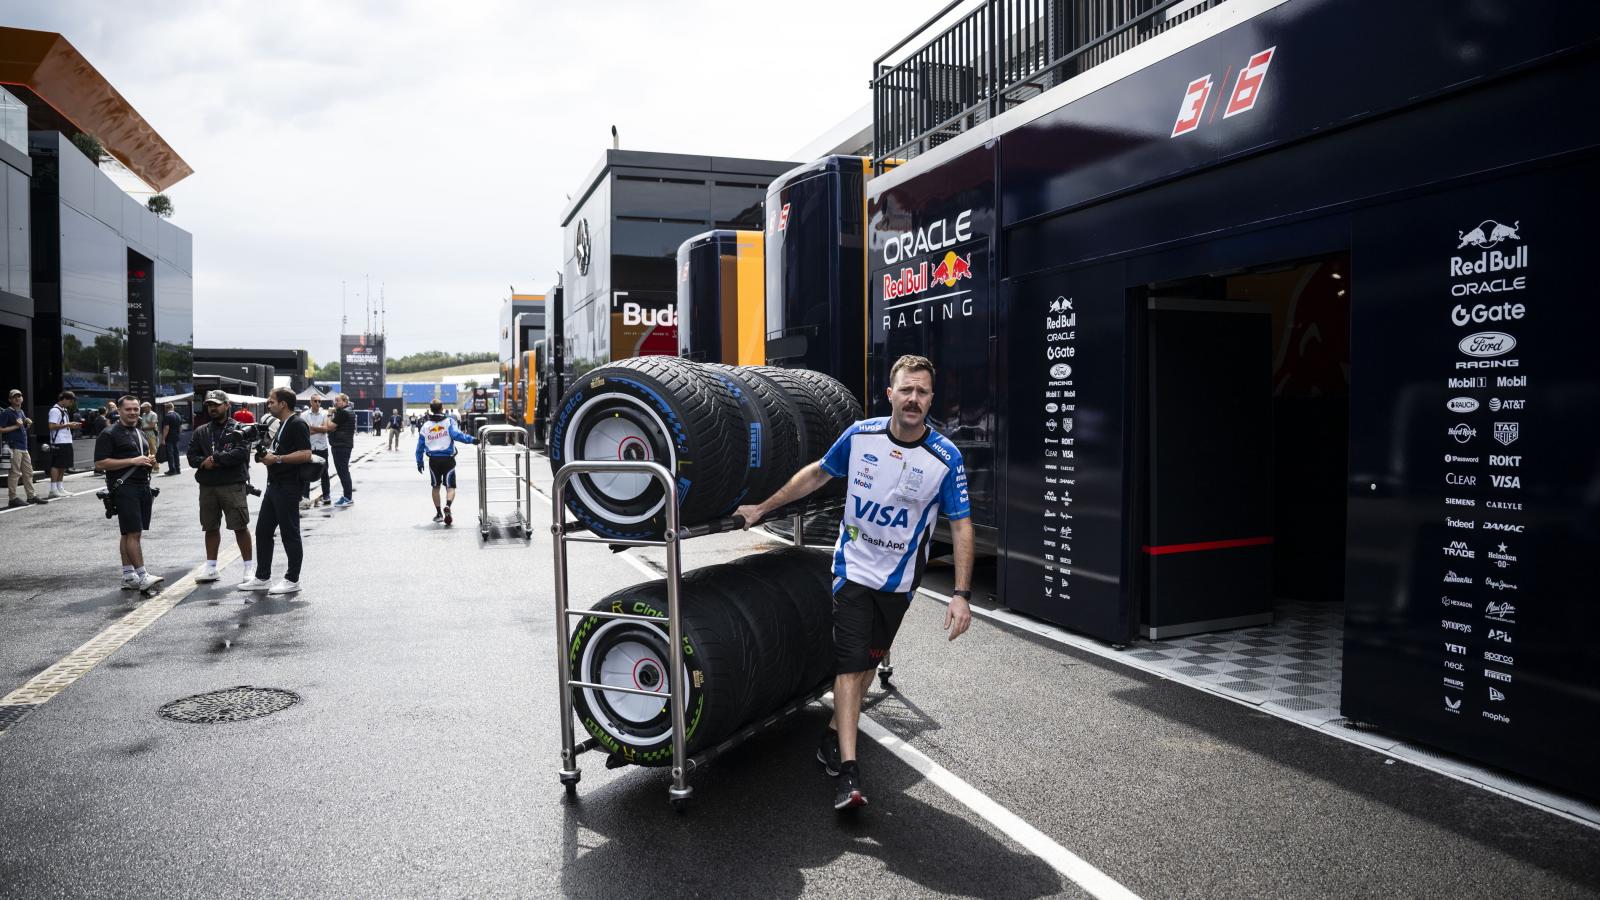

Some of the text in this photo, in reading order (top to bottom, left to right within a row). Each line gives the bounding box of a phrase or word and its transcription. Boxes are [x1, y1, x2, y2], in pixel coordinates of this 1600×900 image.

[1222, 45, 1277, 120] 6
[883, 209, 972, 265] ORACLE
[1450, 245, 1528, 277] Red Bull
[883, 261, 928, 301] Red Bull
[1451, 276, 1527, 297] ORACLE
[623, 302, 678, 327] Bud
[883, 299, 973, 331] RACING
[1471, 302, 1526, 324] Gate
[1046, 312, 1076, 330] Red Bull
[1046, 331, 1076, 342] ORACLE
[1470, 335, 1504, 352] Ford
[1054, 346, 1075, 359] Gate
[1455, 359, 1520, 369] RACING
[1448, 377, 1476, 388] Mobil
[1497, 376, 1527, 387] Mobil
[1455, 400, 1475, 408] RAUCH
[1502, 400, 1526, 410] AT&T
[552, 391, 584, 461] Cinturato
[859, 424, 882, 432] HUGO
[1448, 427, 1477, 438] Hard Rock
[1495, 431, 1518, 444] HEUER
[750, 422, 761, 468] PIRELLI
[932, 443, 952, 461] HUGO
[1489, 455, 1522, 467] ROKT
[853, 478, 872, 490] Mobil
[1445, 472, 1477, 486] CLEAR
[1489, 474, 1521, 489] VISA
[1445, 497, 1476, 507] SIEMENS
[1486, 501, 1523, 511] CARLYLE
[851, 494, 909, 529] VISA
[1446, 516, 1475, 529] indeed
[1482, 521, 1525, 533] DAMAC
[861, 533, 905, 551] Cash App
[1449, 540, 1468, 549] AVA
[1443, 547, 1476, 559] TRADE
[1488, 551, 1517, 562] Heineken
[1450, 599, 1473, 608] HEXAGON
[1441, 619, 1472, 633] SYNOPSYS
[1444, 642, 1467, 655] YETI
[1484, 651, 1514, 663] sparco
[1443, 677, 1465, 687] PHILIPS
[1484, 668, 1512, 683] PIRELLI
[1482, 711, 1511, 724] mophie
